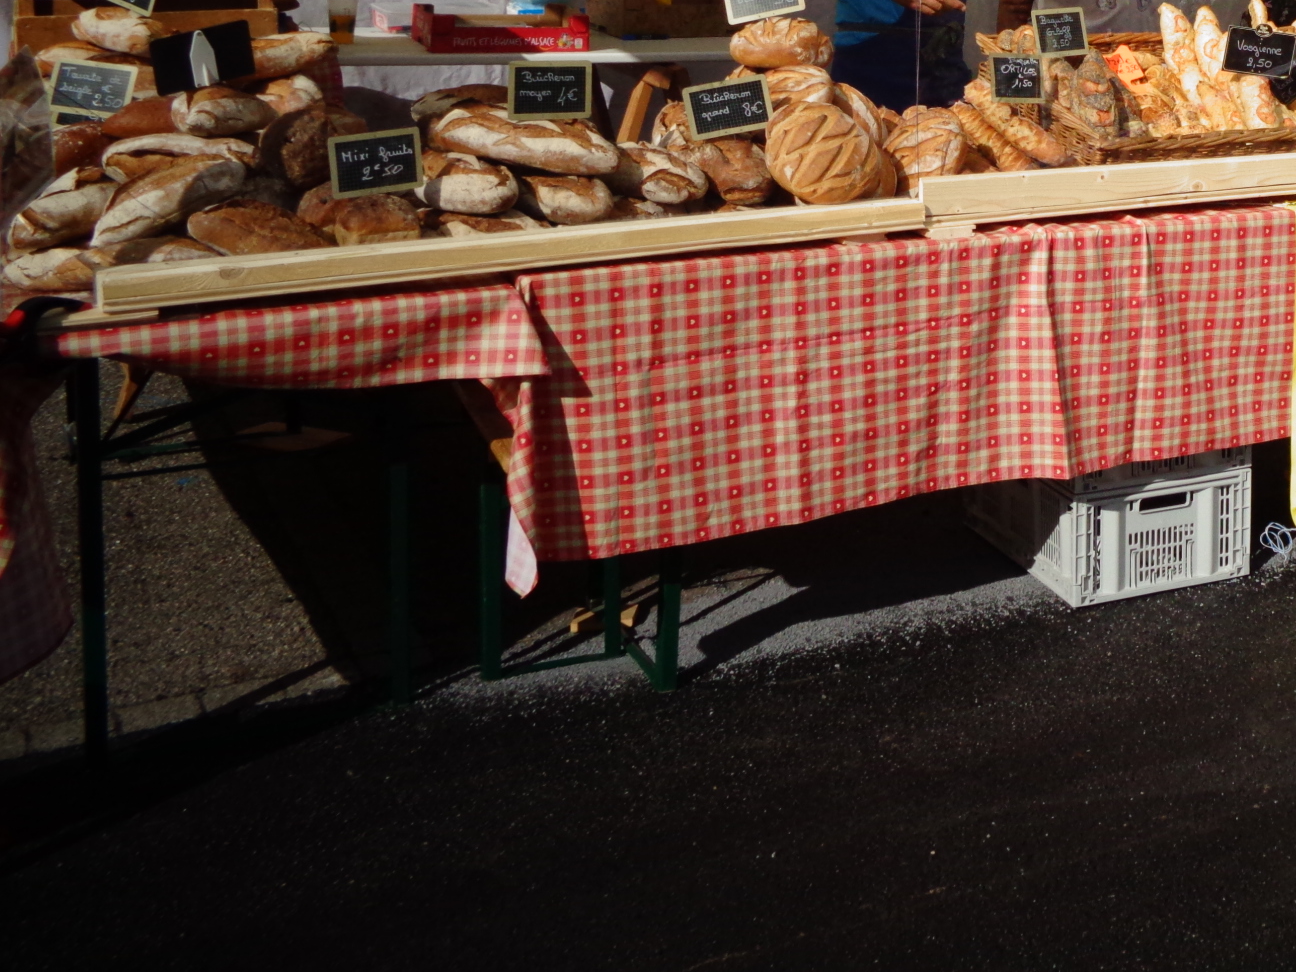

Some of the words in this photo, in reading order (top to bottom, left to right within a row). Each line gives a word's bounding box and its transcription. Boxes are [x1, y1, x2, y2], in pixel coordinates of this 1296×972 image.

[453, 36, 476, 46] FRUITS
[480, 37, 488, 46] ET
[1237, 39, 1282, 57] Vosgienne
[1247, 58, 1272, 69] 2,50
[520, 90, 551, 101] moyen
[557, 87, 578, 106] 4€
[702, 106, 729, 121] grand
[742, 101, 764, 116] 8€
[342, 148, 368, 162] Mixi
[379, 144, 413, 162] fruits
